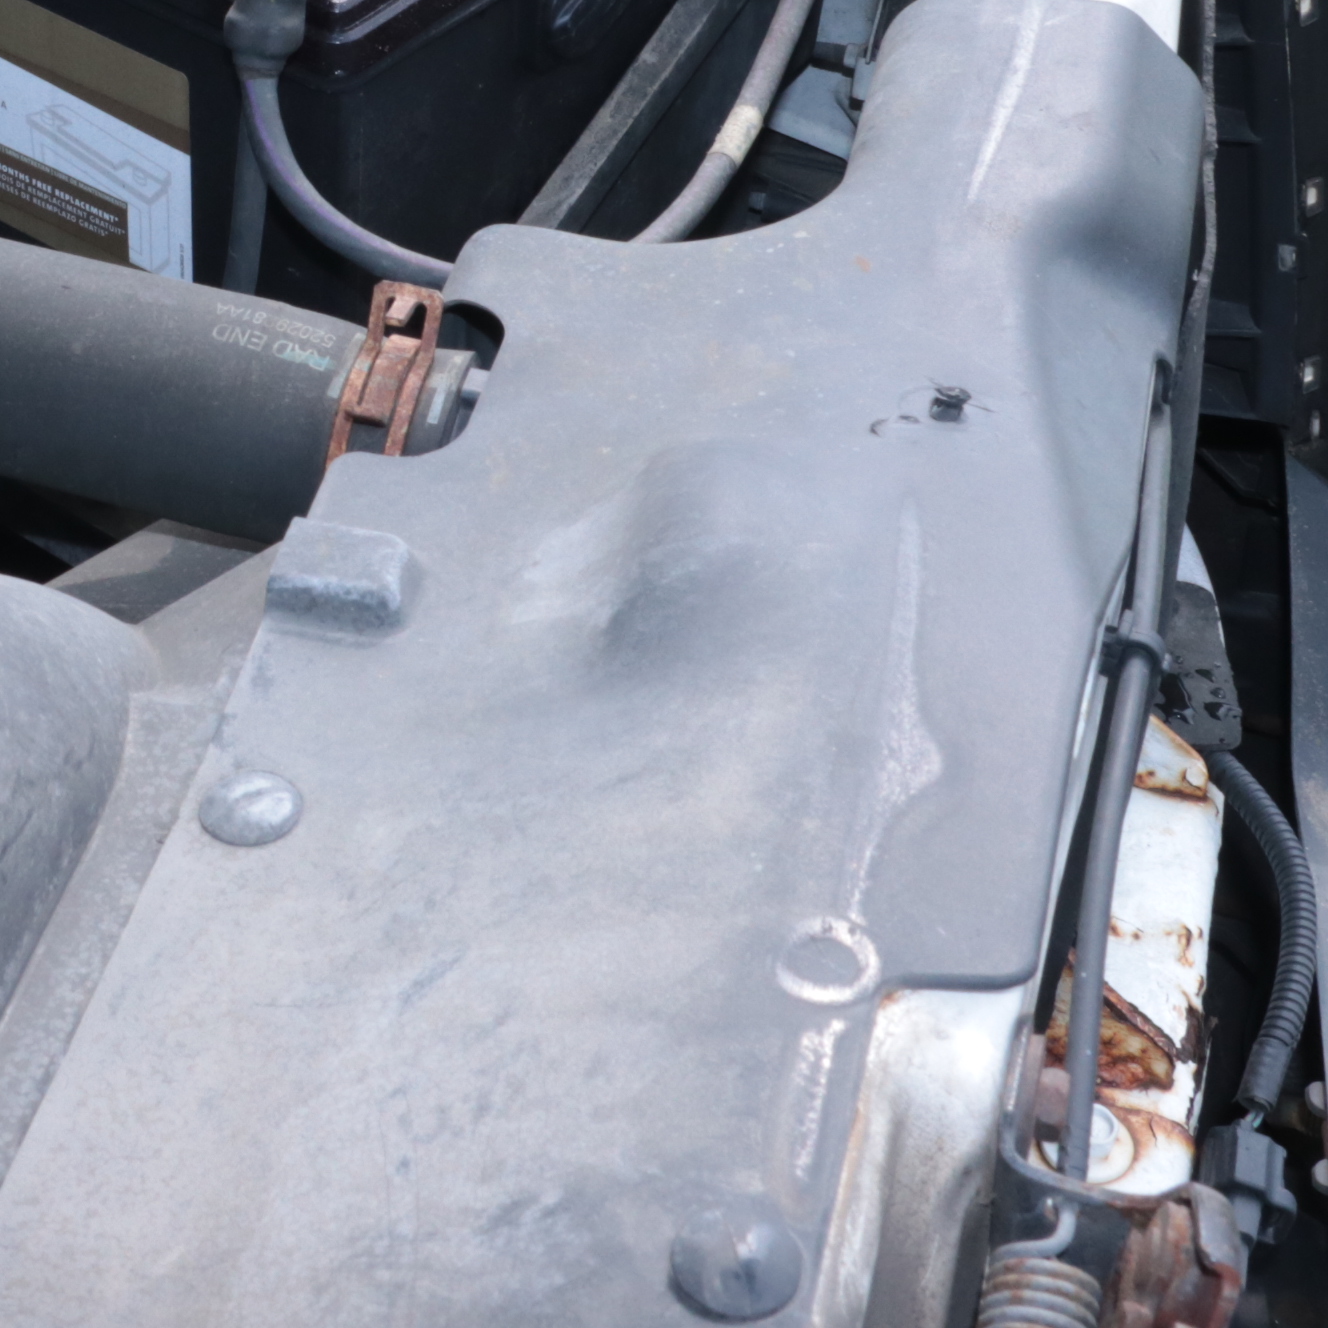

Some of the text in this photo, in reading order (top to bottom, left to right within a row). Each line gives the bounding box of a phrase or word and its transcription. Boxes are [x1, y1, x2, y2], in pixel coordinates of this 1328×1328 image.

[15, 179, 26, 191] DE
[27, 182, 87, 221] REMPLACEMENT
[31, 176, 52, 194] FREE
[20, 190, 29, 202] DE
[32, 194, 76, 225] REEMPLAZO
[212, 323, 268, 353] END
